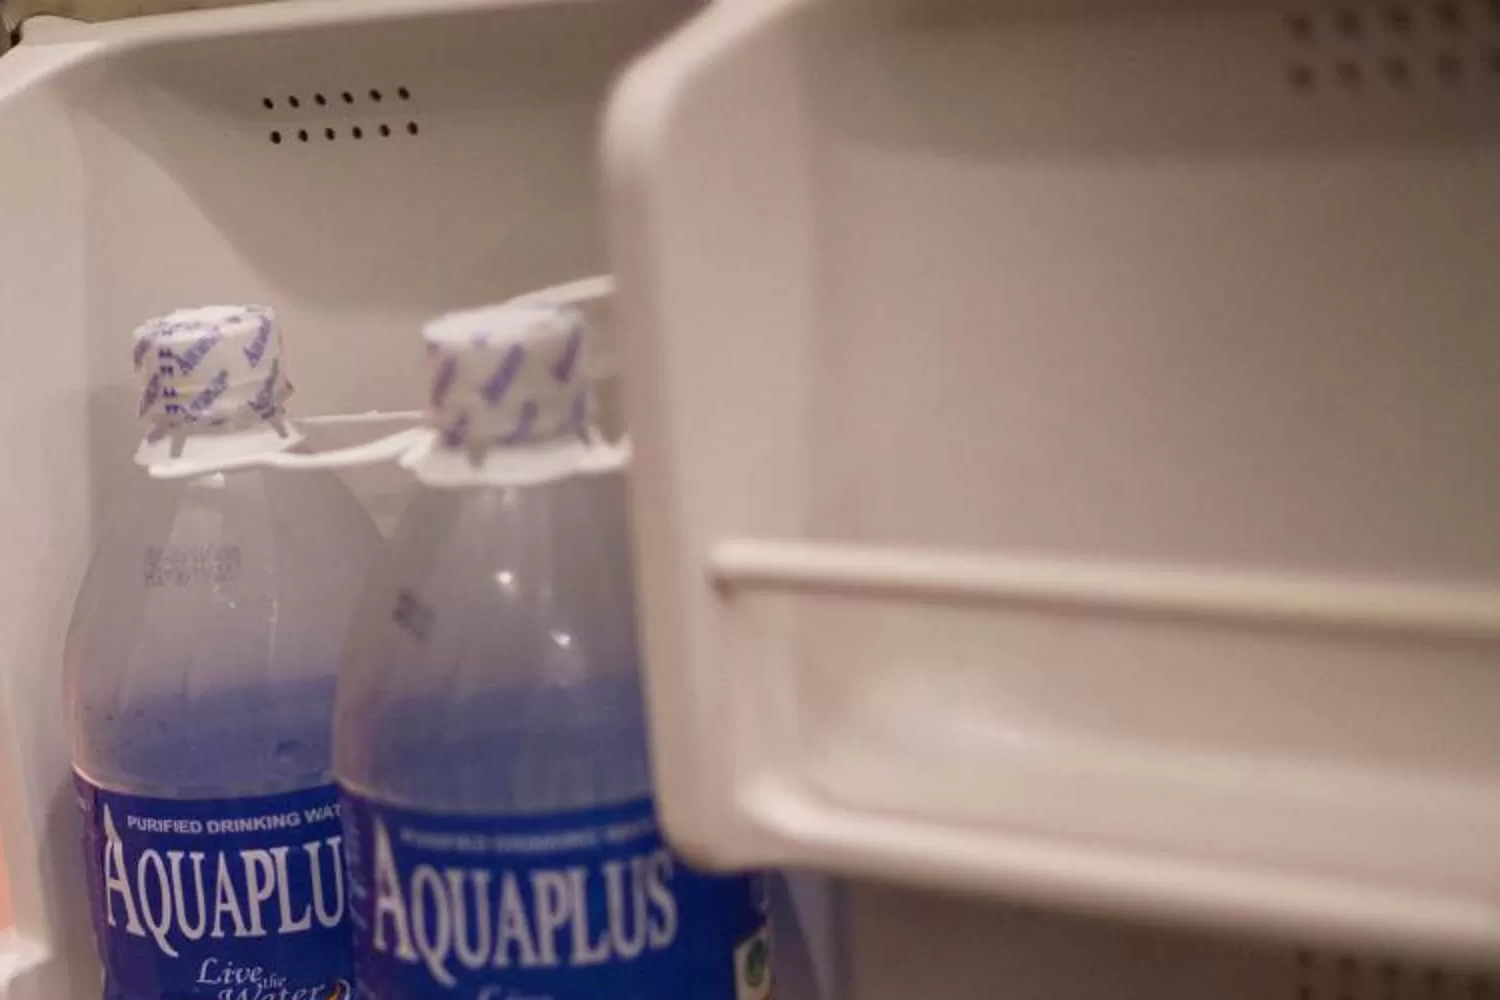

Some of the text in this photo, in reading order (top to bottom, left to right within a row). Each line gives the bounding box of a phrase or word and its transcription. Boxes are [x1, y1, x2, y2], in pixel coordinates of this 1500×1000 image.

[127, 803, 342, 834] PURIFIED DRINKING WAT
[101, 803, 346, 958] AQUAPLU
[373, 815, 678, 987] AQUAPLUS
[196, 956, 264, 985] Live
